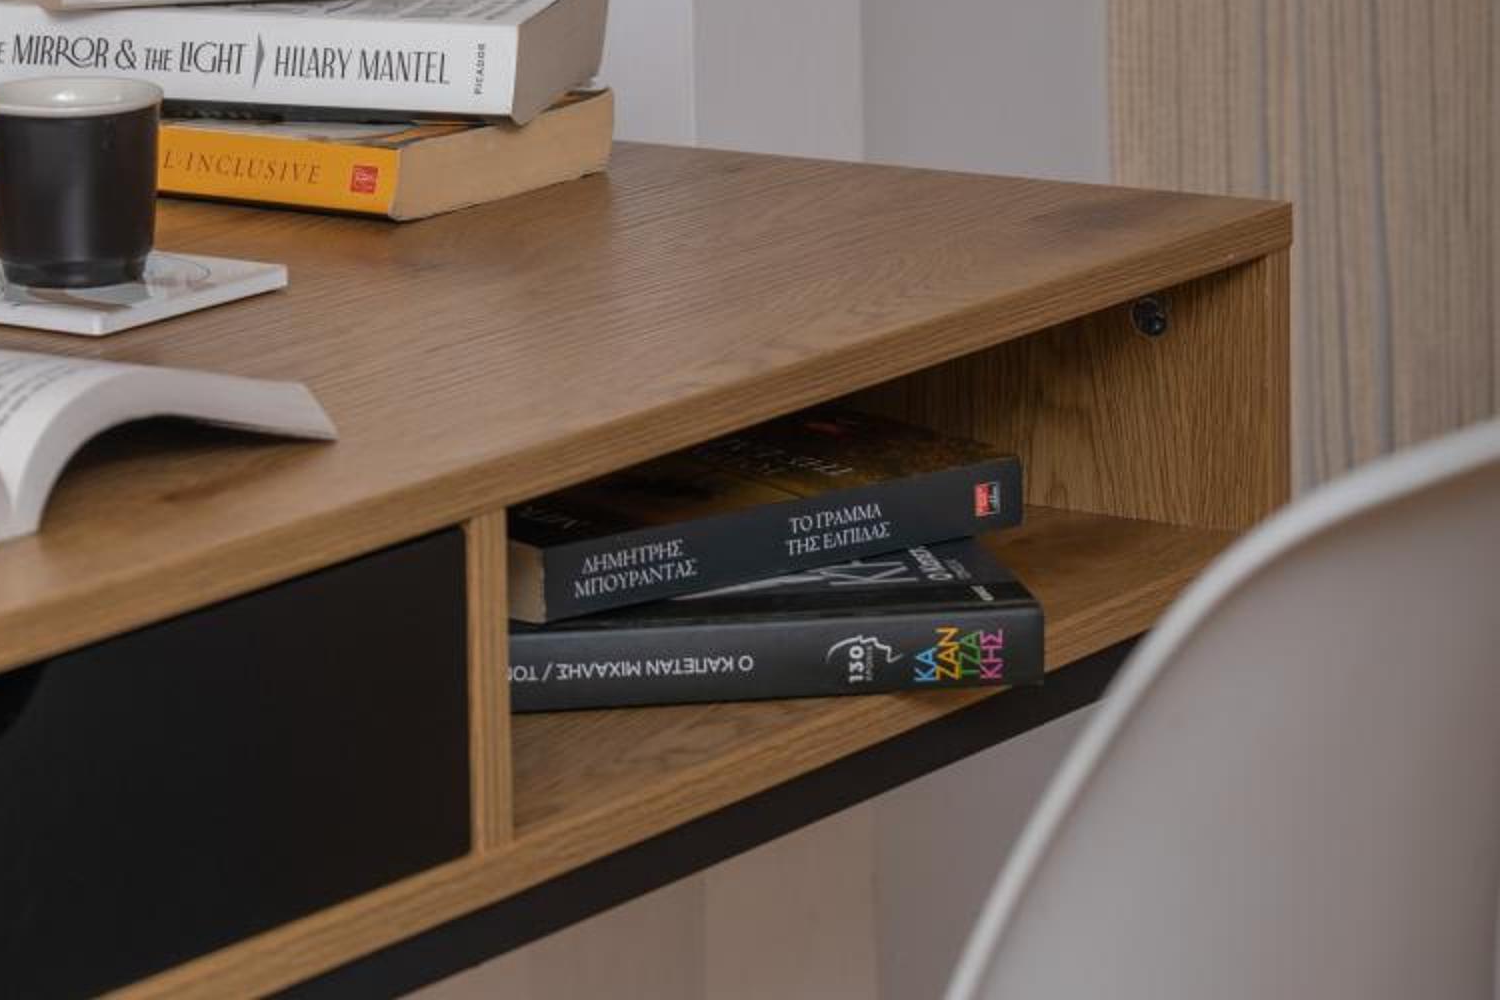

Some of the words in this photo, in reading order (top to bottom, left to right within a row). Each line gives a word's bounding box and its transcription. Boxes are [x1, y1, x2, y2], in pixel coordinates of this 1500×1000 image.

[12, 33, 109, 69] MIRROR
[115, 39, 137, 70] &
[144, 47, 172, 71] THE
[180, 41, 248, 75] LIGHT
[275, 45, 352, 80] HILARY
[358, 49, 450, 85] MANTEL
[788, 515, 813, 534] ΤΟ
[816, 503, 883, 529] ΓΡΑΜΜΑ
[785, 535, 821, 556] ΤΗΣ
[823, 521, 892, 549] ΕΛΠΙΔΑΣ
[581, 539, 684, 575] ΔΗΜΗΤΡΗΣ
[574, 558, 699, 599] ΜΠΟΥΡΑΝΤΑΣ
[556, 660, 641, 681] ΜΙΧΑΛΗΣ
[646, 656, 734, 676] ΚΑΠΕΤΑΝ
[738, 655, 754, 671] Ο
[849, 645, 865, 683] 130
[914, 648, 937, 682] ΚΑ
[935, 627, 961, 680] ΖΑΝ
[979, 629, 1003, 679] ΚΗΣ
